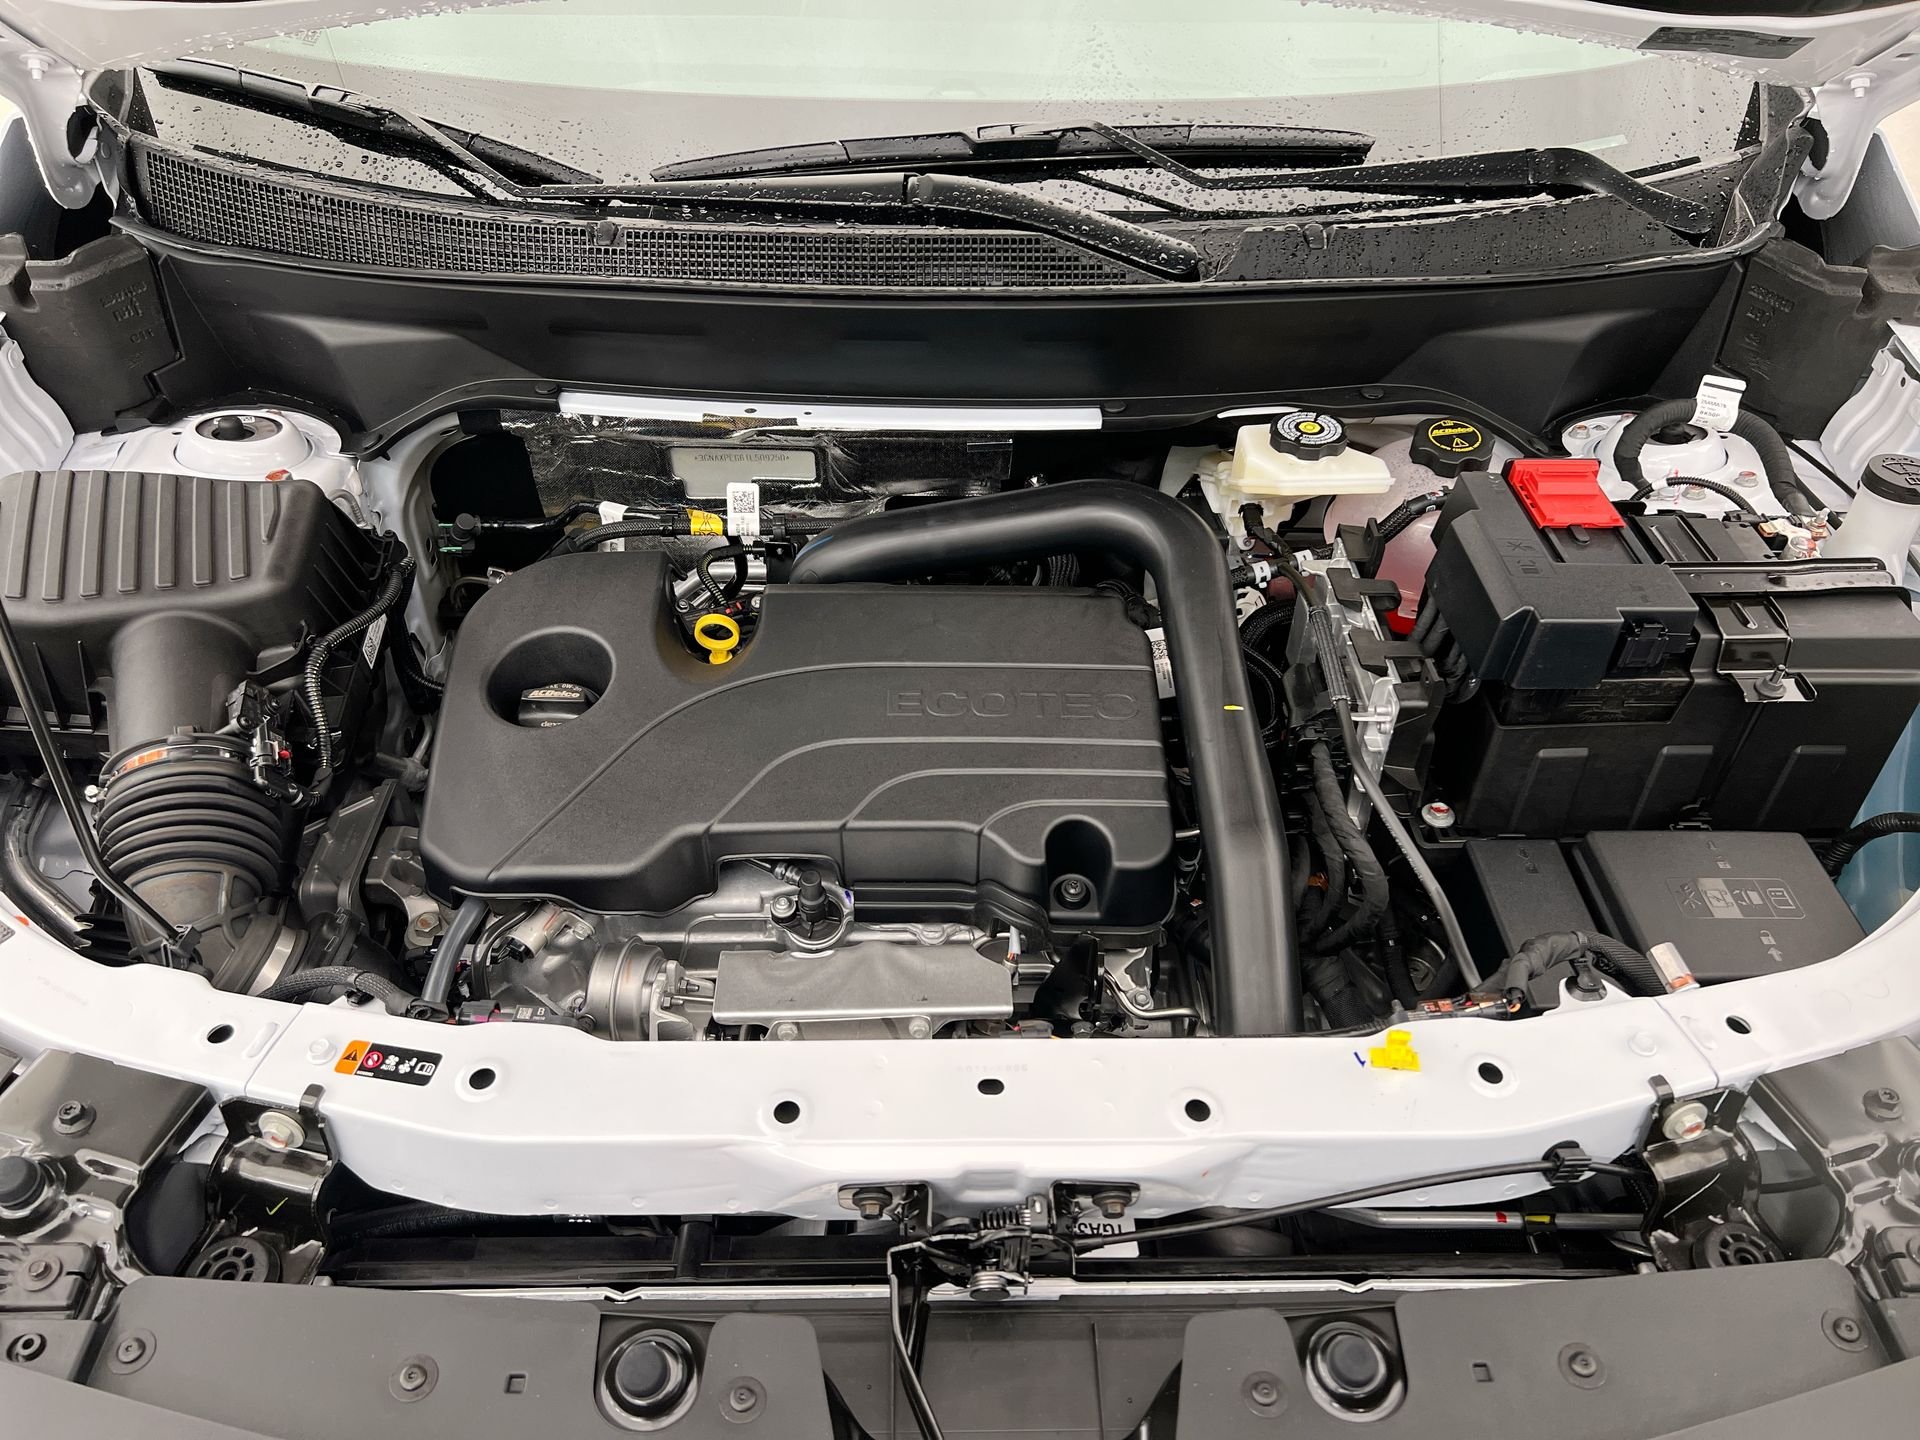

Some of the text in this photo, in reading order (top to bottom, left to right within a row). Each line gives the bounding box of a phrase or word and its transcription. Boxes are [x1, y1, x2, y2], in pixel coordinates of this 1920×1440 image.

[528, 690, 580, 699] ACDelco
[887, 689, 1139, 720] ECOTEC
[380, 1064, 396, 1072] AUTO
